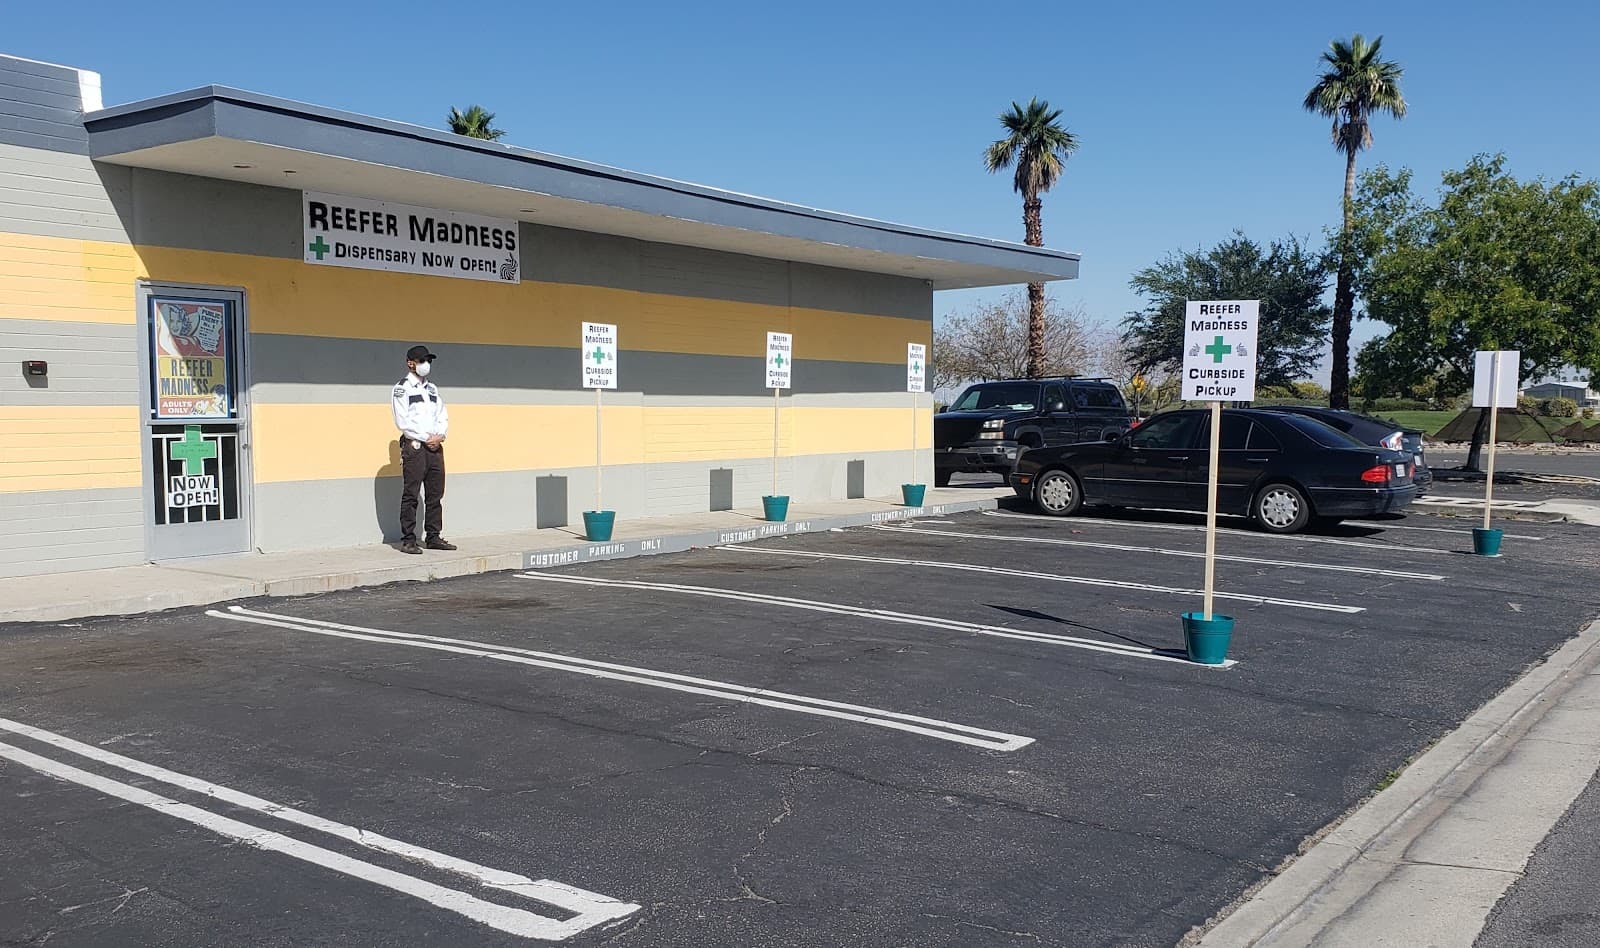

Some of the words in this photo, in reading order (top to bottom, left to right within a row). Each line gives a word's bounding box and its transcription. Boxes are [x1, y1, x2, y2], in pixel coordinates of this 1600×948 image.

[309, 201, 398, 237] REEFER
[422, 252, 454, 268] NOW
[1200, 304, 1241, 315] REEFER
[171, 360, 213, 377] REEFER
[1189, 368, 1245, 379] CURBSIDE
[161, 378, 209, 396] MADNESS
[1195, 385, 1237, 397] PICKUP
[162, 400, 193, 408] ADULTS
[173, 476, 210, 492] NOW
[721, 529, 756, 543] CUSTOMER
[761, 523, 788, 535] PARKING
[795, 521, 811, 532] ONLY
[530, 550, 578, 566] CUSTOMER
[589, 543, 625, 557] PARKING
[641, 538, 662, 551] ONLY
